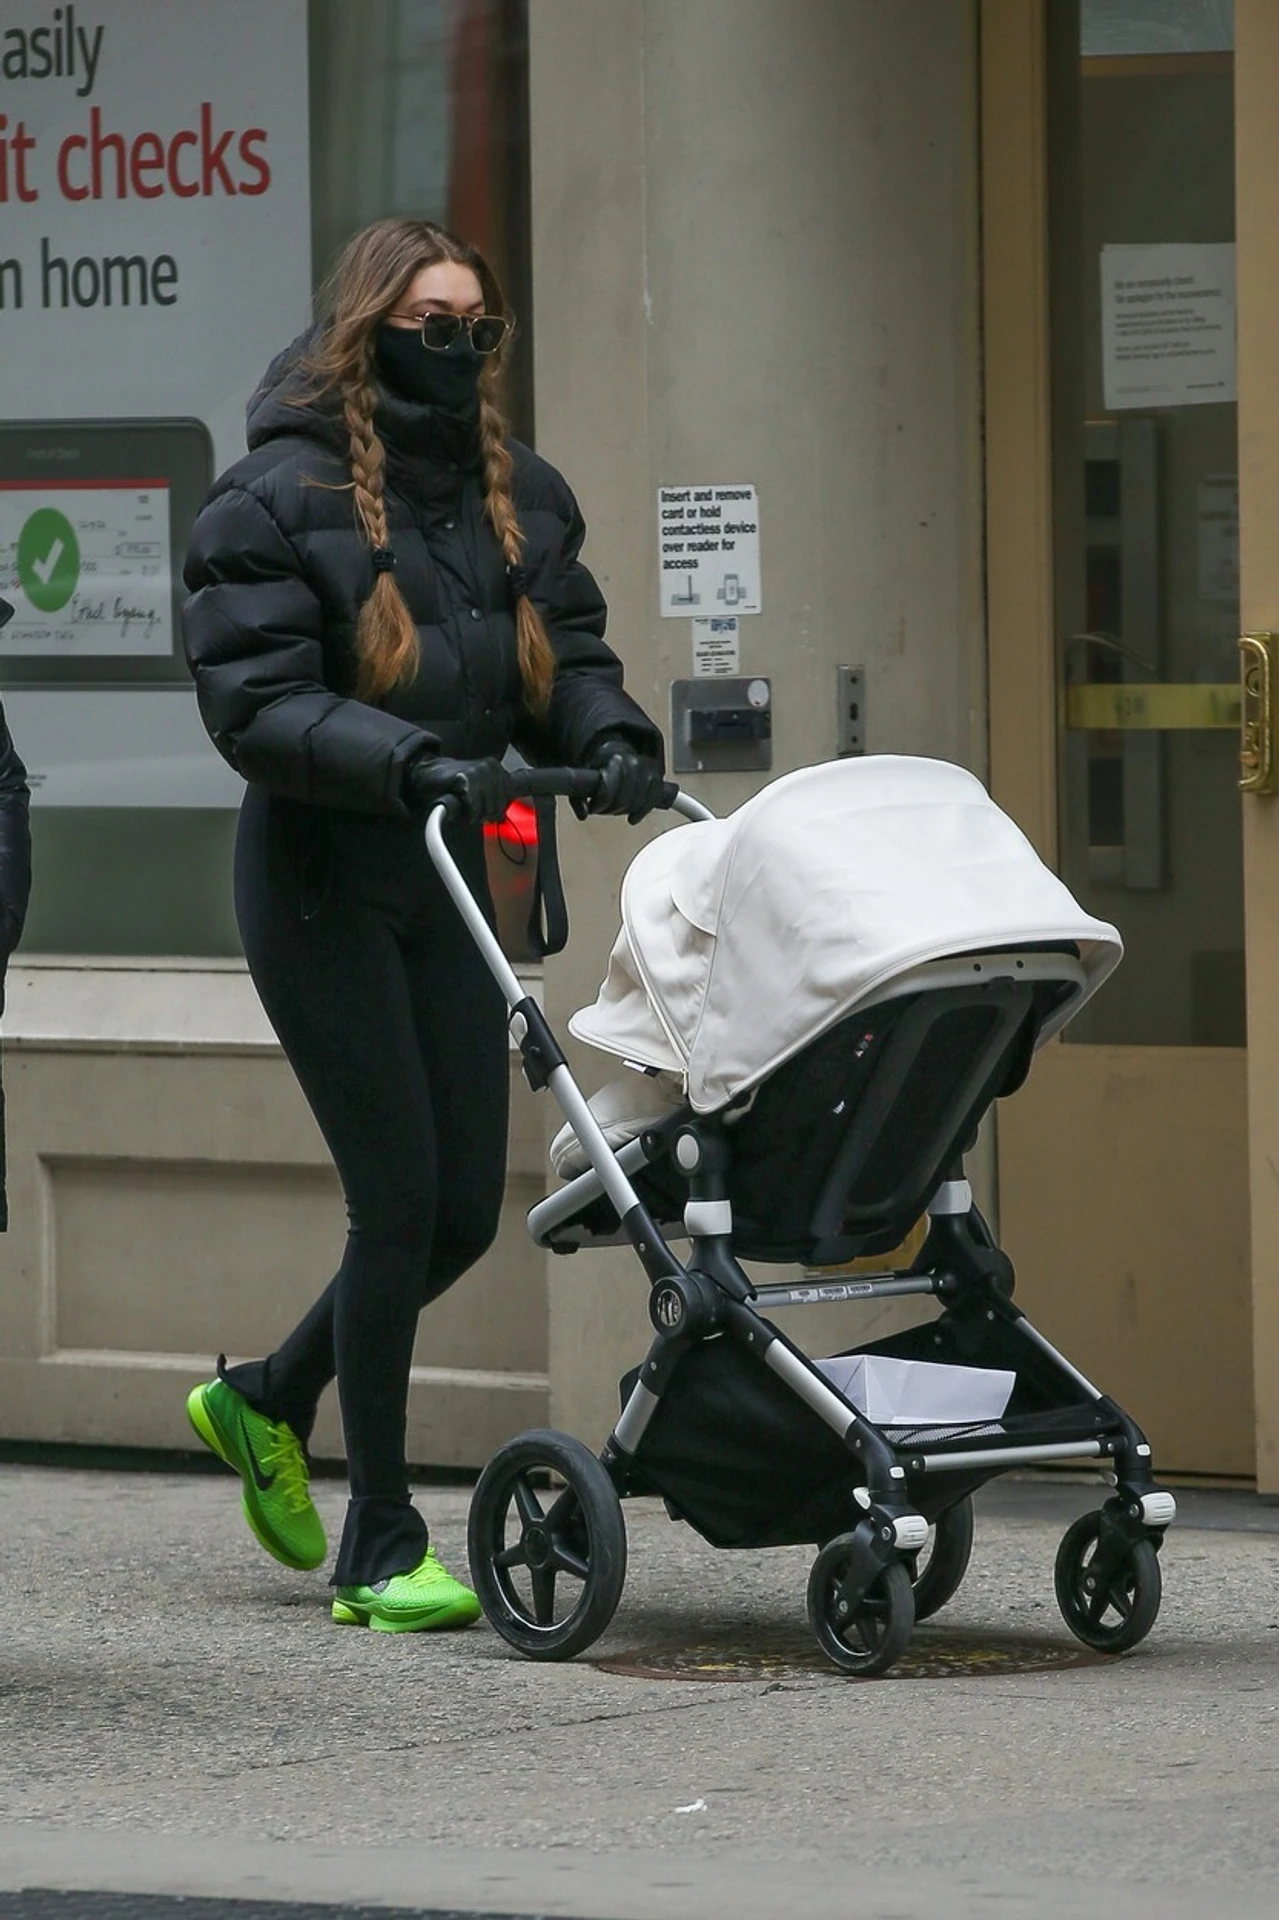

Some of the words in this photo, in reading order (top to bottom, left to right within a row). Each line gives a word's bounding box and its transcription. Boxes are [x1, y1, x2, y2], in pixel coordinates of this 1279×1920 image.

[2, 4, 105, 97] asily
[57, 102, 271, 201] checks
[41, 237, 178, 309] home
[661, 490, 691, 503] Insert
[694, 489, 712, 502] and
[715, 490, 752, 501] remove
[661, 507, 684, 519] card
[687, 508, 697, 518] or
[700, 505, 721, 518] hold
[662, 522, 721, 536] contactless
[724, 521, 757, 534] device
[662, 542, 684, 553] over
[687, 539, 719, 552] reader
[722, 538, 736, 550] for
[663, 558, 699, 570] access
